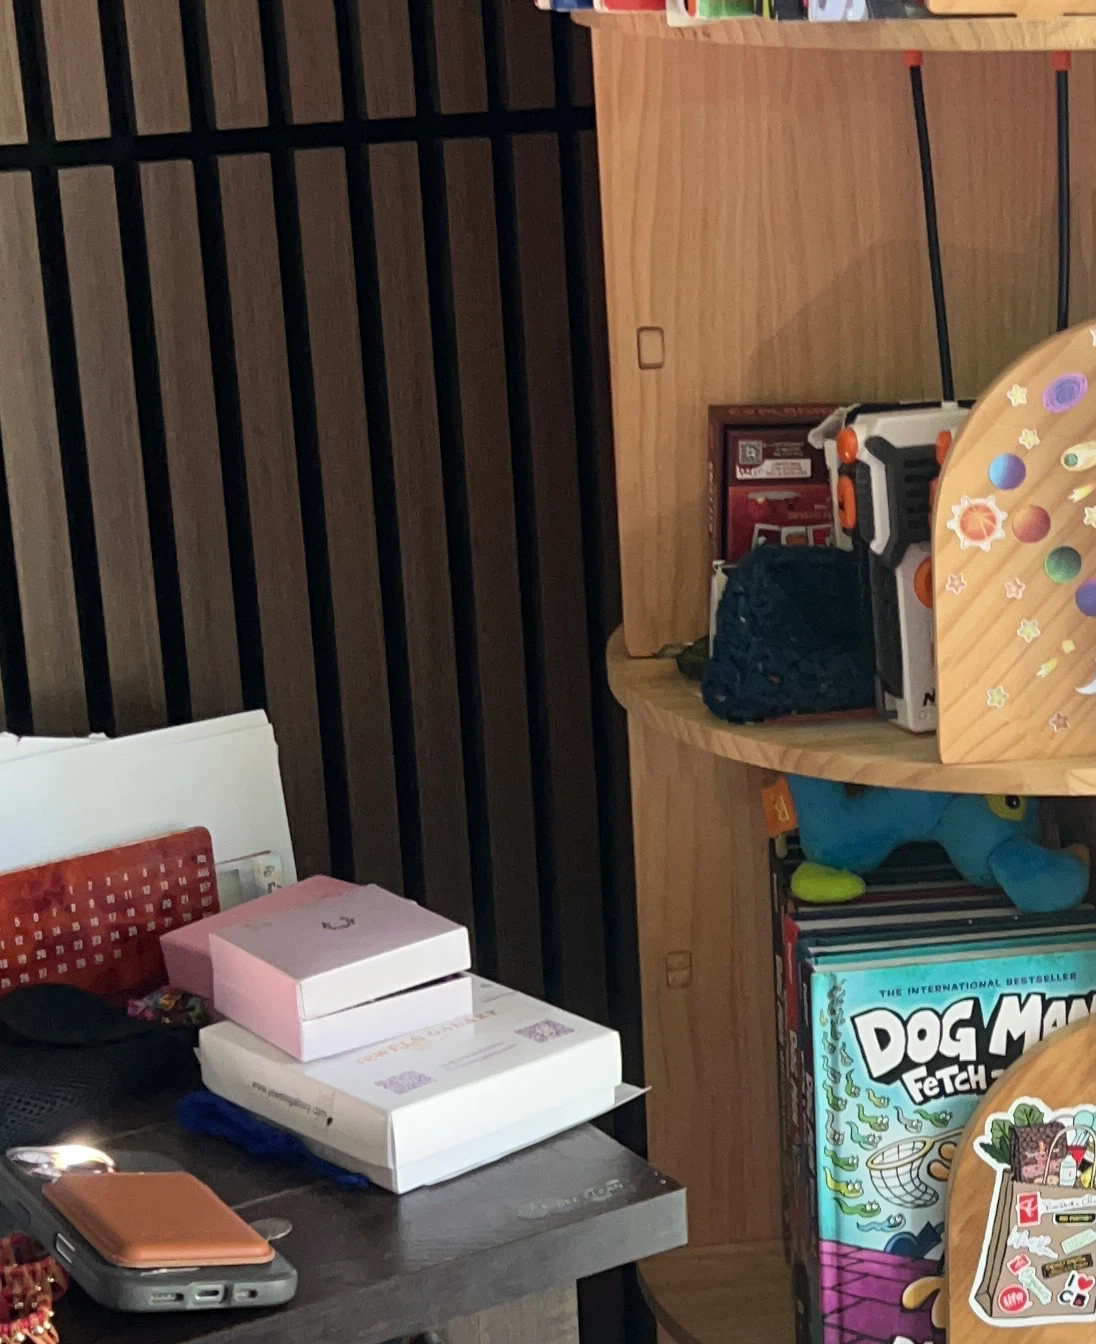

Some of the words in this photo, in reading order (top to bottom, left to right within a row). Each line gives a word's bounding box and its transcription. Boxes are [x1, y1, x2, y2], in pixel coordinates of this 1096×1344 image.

[878, 988, 903, 998] THE
[907, 979, 1001, 996] INTERNATIONAL
[1006, 972, 1078, 986] BESTSELLER
[853, 998, 978, 1079] DOG
